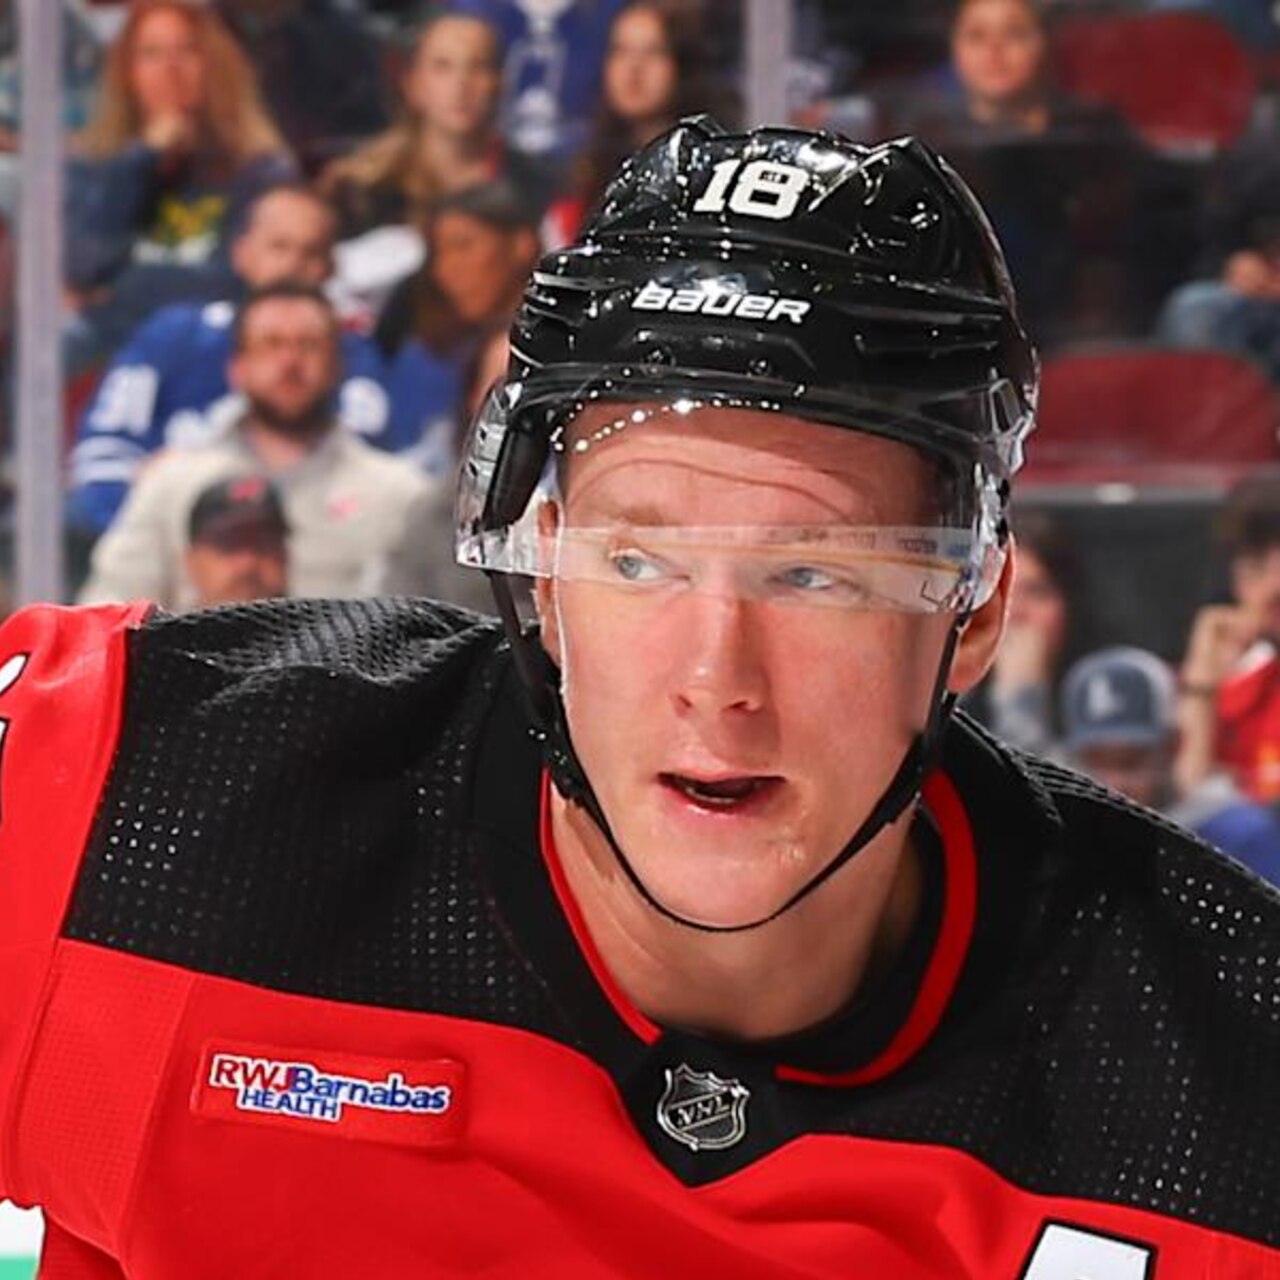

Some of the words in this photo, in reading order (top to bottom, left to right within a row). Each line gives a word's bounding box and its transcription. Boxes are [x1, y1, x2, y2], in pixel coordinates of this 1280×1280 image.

[693, 159, 810, 219] 18
[631, 281, 811, 324] BAUER
[240, 1086, 339, 1120] HEALTH
[678, 1096, 730, 1126] NHL
